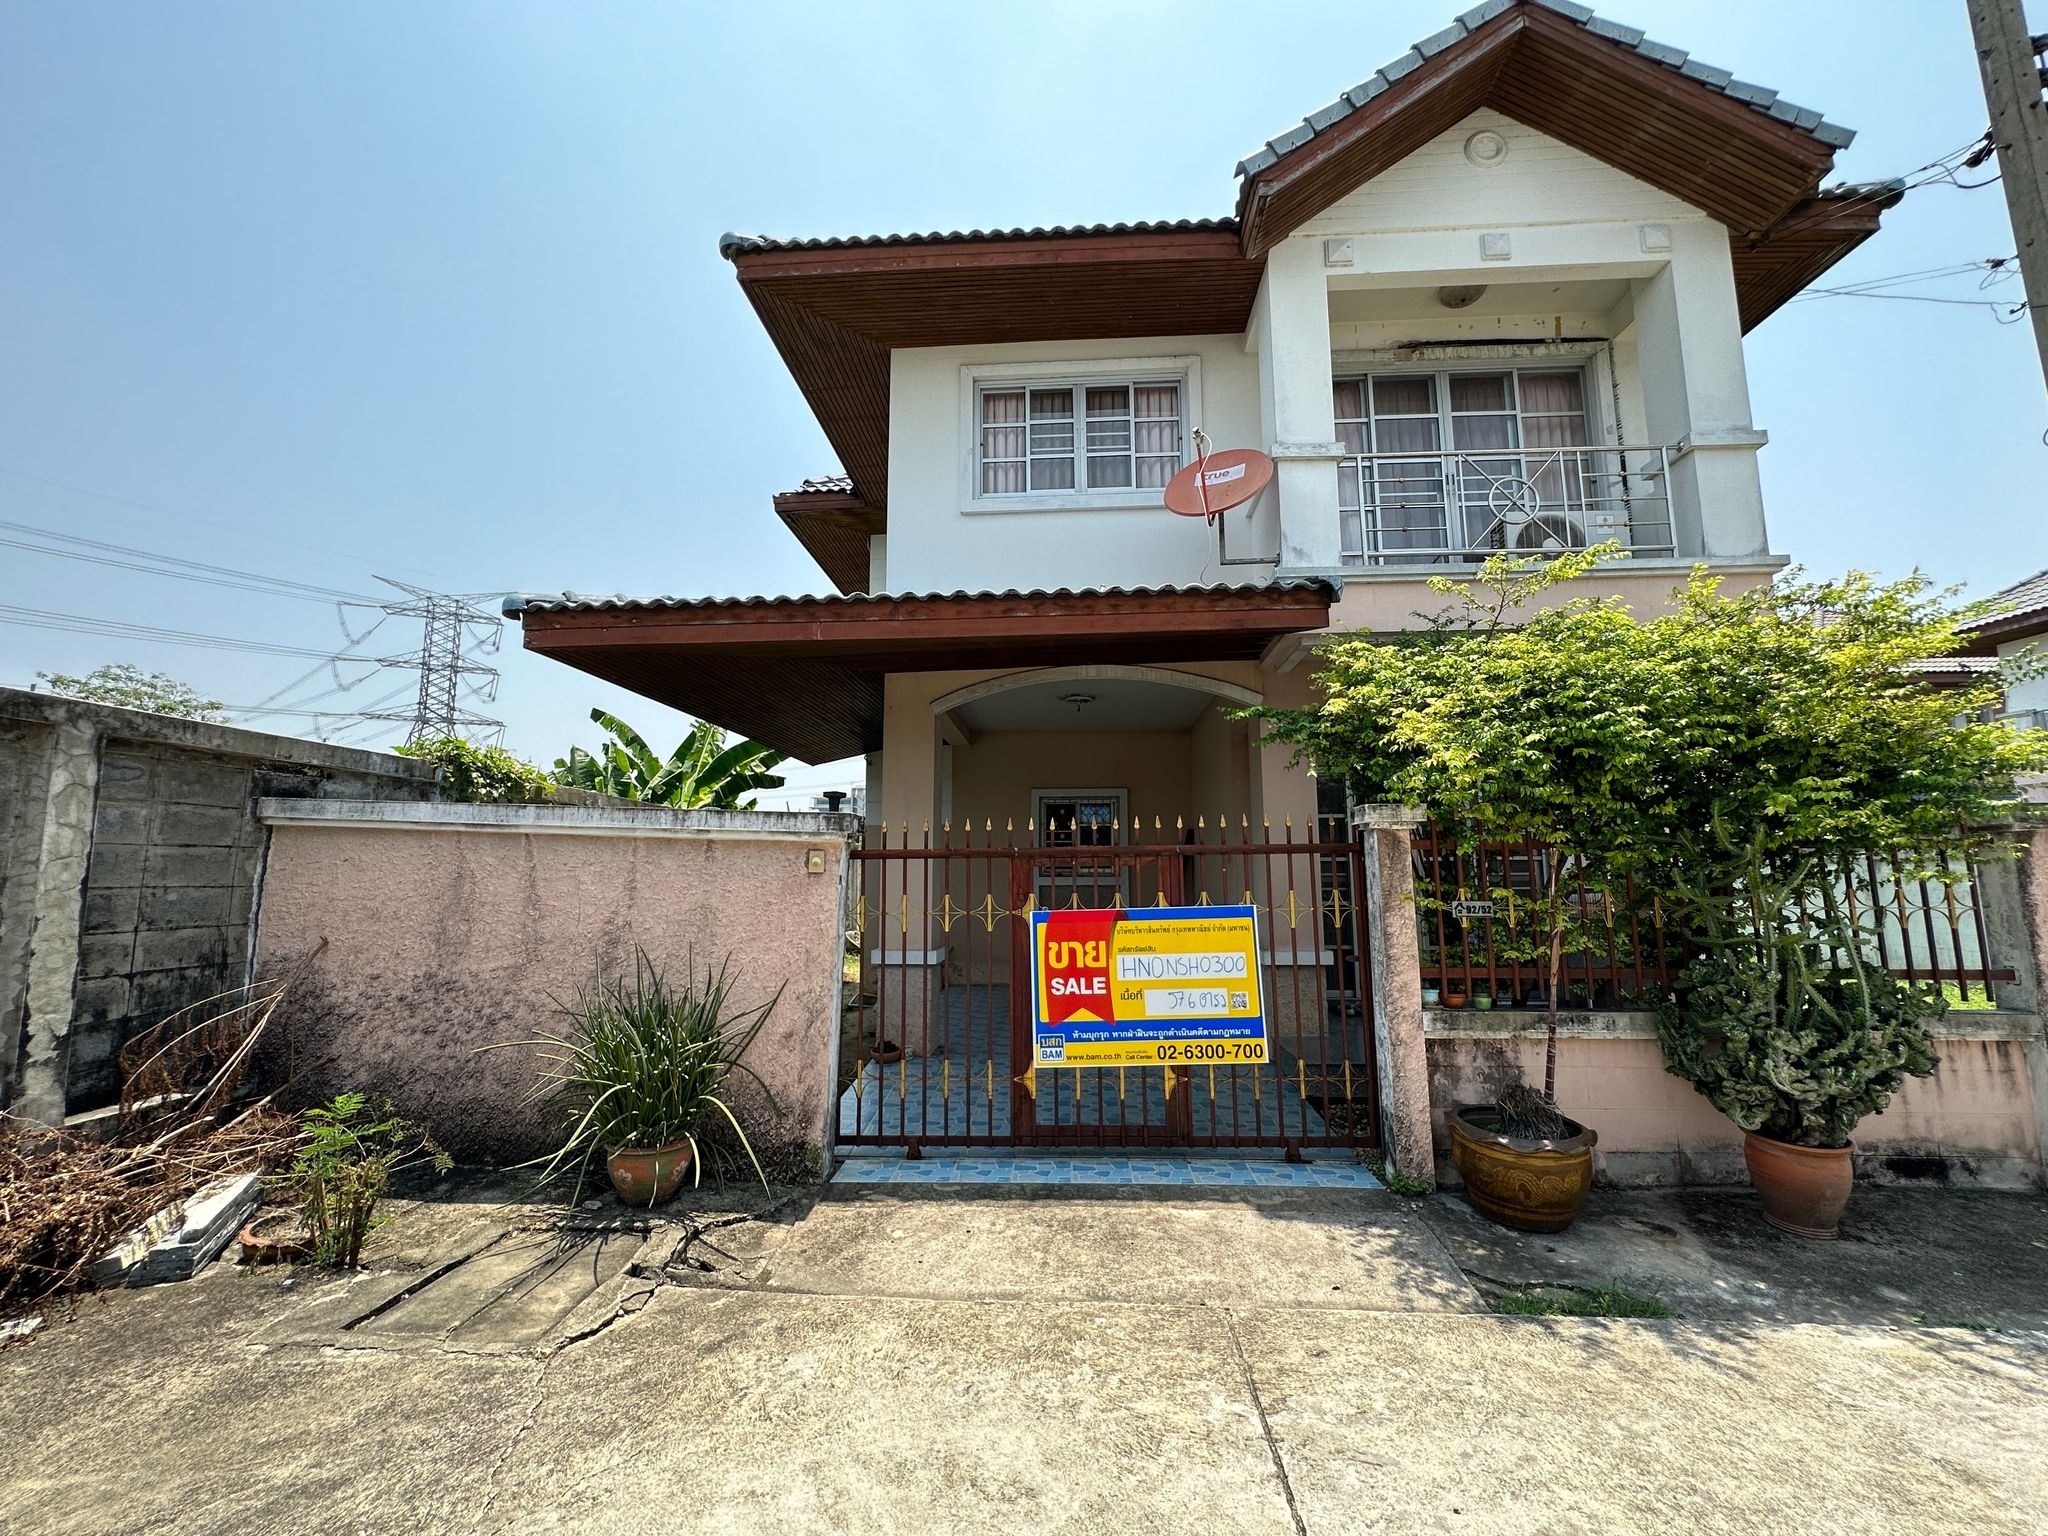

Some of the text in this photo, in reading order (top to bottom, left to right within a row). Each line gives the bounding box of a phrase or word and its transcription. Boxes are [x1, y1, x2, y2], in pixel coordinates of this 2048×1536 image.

[1466, 904, 1492, 915] 92/52
[1212, 921, 1227, 933] จำกัด
[1228, 922, 1250, 933] (มหาชน)
[1048, 940, 1107, 969] ขาย
[1050, 977, 1107, 996] SALE
[1120, 987, 1143, 1001] เนื้อที่
[1072, 1029, 1110, 1041] ห้ามบุกรุก
[1041, 1037, 1062, 1047] บสก
[1041, 1049, 1063, 1060] BAM
[1066, 1053, 1122, 1061] www.bam.co.th
[1157, 1043, 1264, 1060] 02-6300-700
